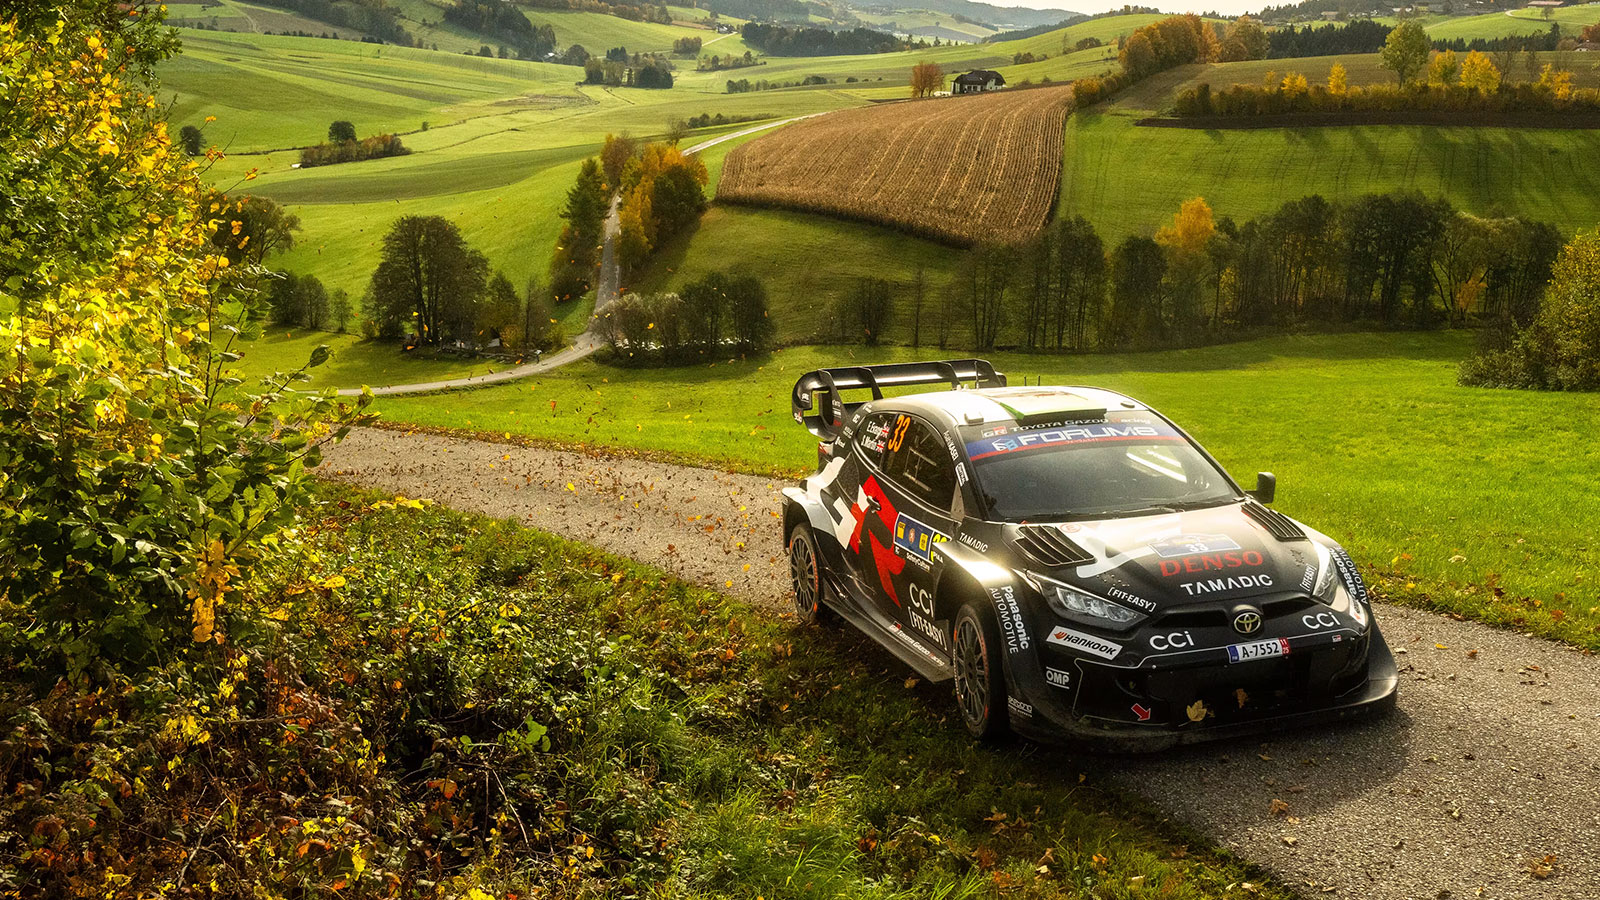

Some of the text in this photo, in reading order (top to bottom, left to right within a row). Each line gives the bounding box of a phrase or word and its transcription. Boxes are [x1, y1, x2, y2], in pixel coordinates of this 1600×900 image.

[888, 414, 911, 452] 33
[1010, 421, 1062, 432] TOYOTA
[1064, 418, 1109, 427] GAZOO
[1018, 426, 1159, 446] FORUM8
[959, 532, 989, 553] TAMADIC
[1185, 543, 1209, 552] 33
[1158, 550, 1263, 577] DENSO
[1180, 574, 1273, 596] TAMADIC
[989, 587, 1019, 654] AUTOMOTIVE
[1001, 585, 1031, 650] Panasonic
[1302, 611, 1341, 629] CCi
[1149, 631, 1194, 651] CCi
[1241, 642, 1280, 658] A-7552
[1046, 670, 1070, 686] OMP
